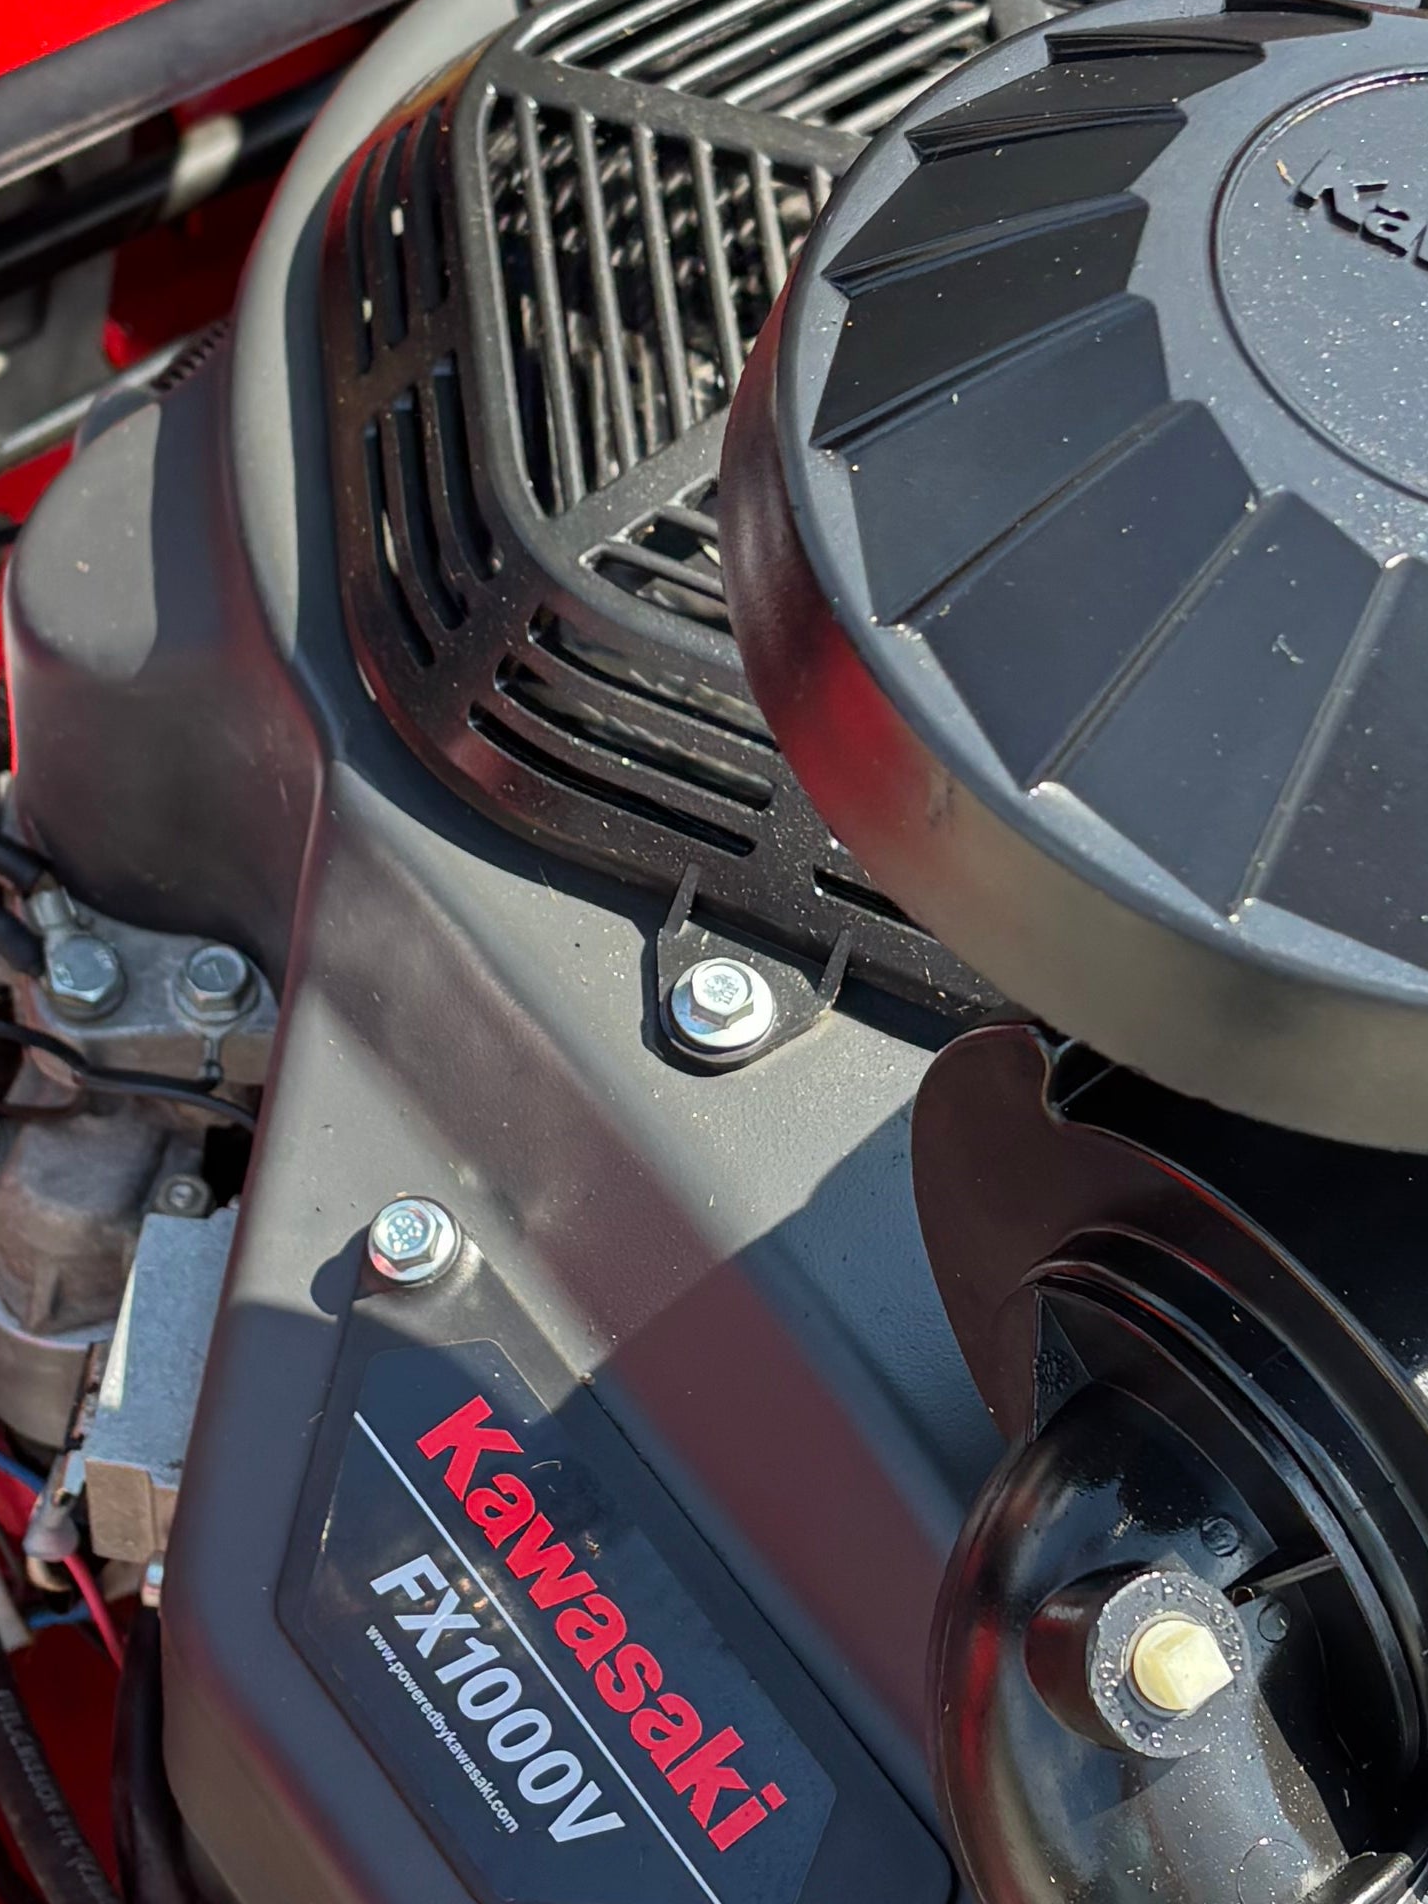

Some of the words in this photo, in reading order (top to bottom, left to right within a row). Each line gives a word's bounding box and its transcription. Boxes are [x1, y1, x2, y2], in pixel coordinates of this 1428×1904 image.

[365, 1622, 521, 1835] www.poweredbykawasaki.com
[369, 1553, 626, 1843] FX1000V
[416, 1394, 788, 1852] Kawasaki
